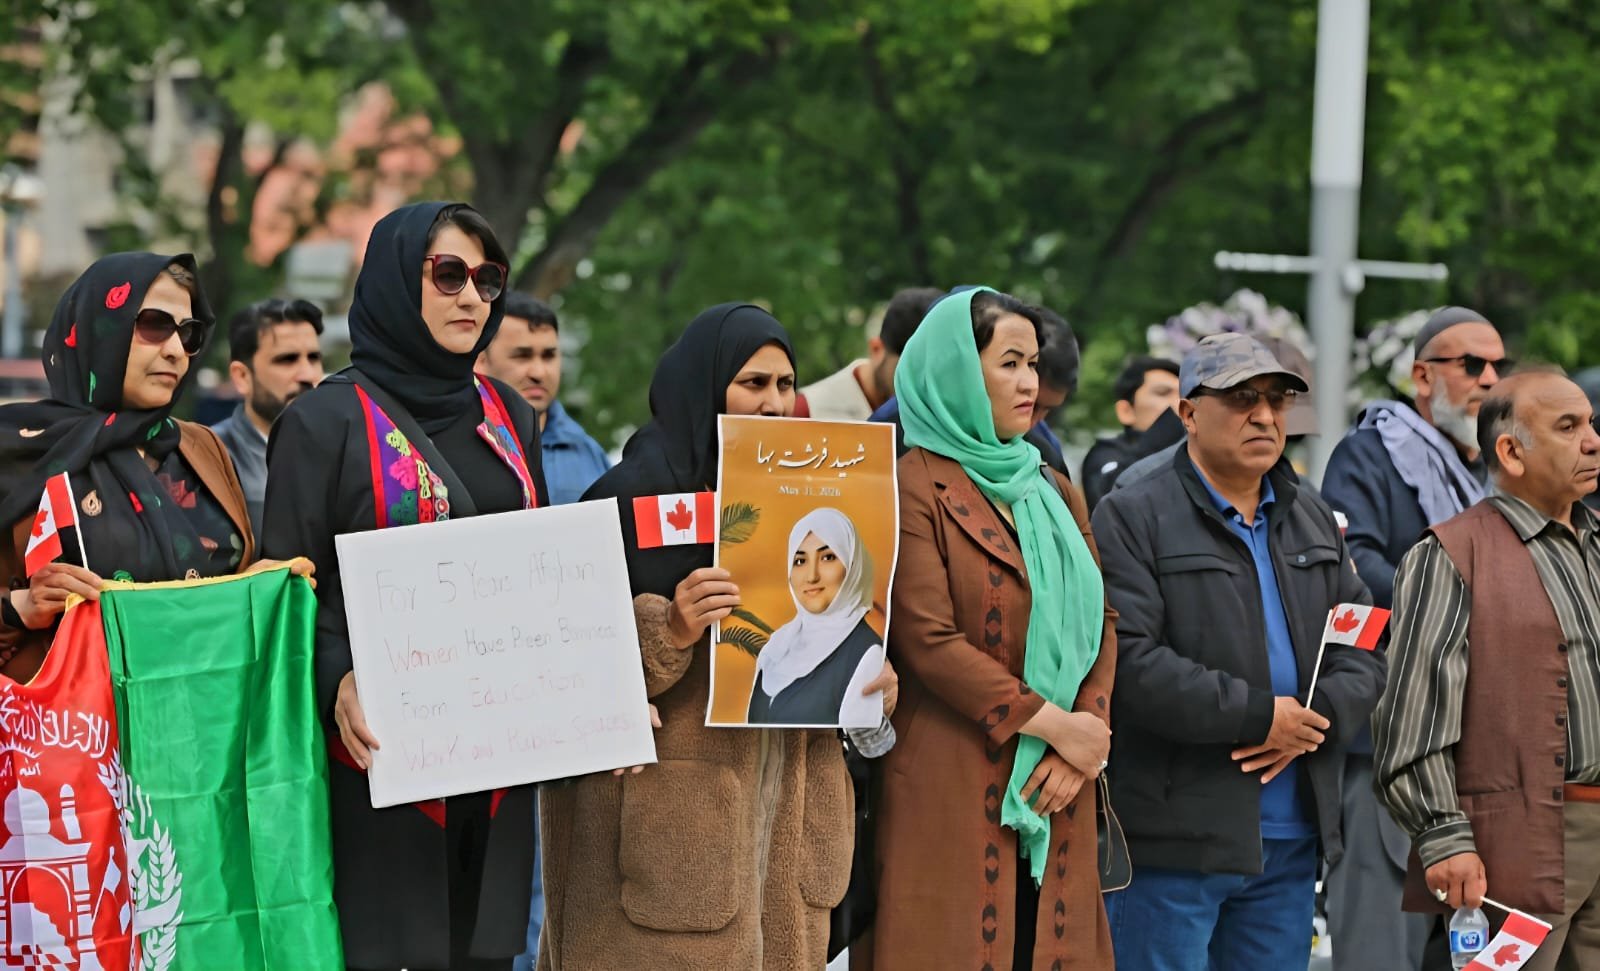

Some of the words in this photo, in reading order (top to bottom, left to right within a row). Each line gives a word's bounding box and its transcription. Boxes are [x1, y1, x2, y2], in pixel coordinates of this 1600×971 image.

[778, 485, 800, 497] May
[436, 561, 457, 604] 5
[463, 560, 514, 601] Years
[384, 633, 459, 674] Women
[464, 625, 506, 656] Have
[511, 624, 552, 649] Been
[400, 690, 448, 721] From
